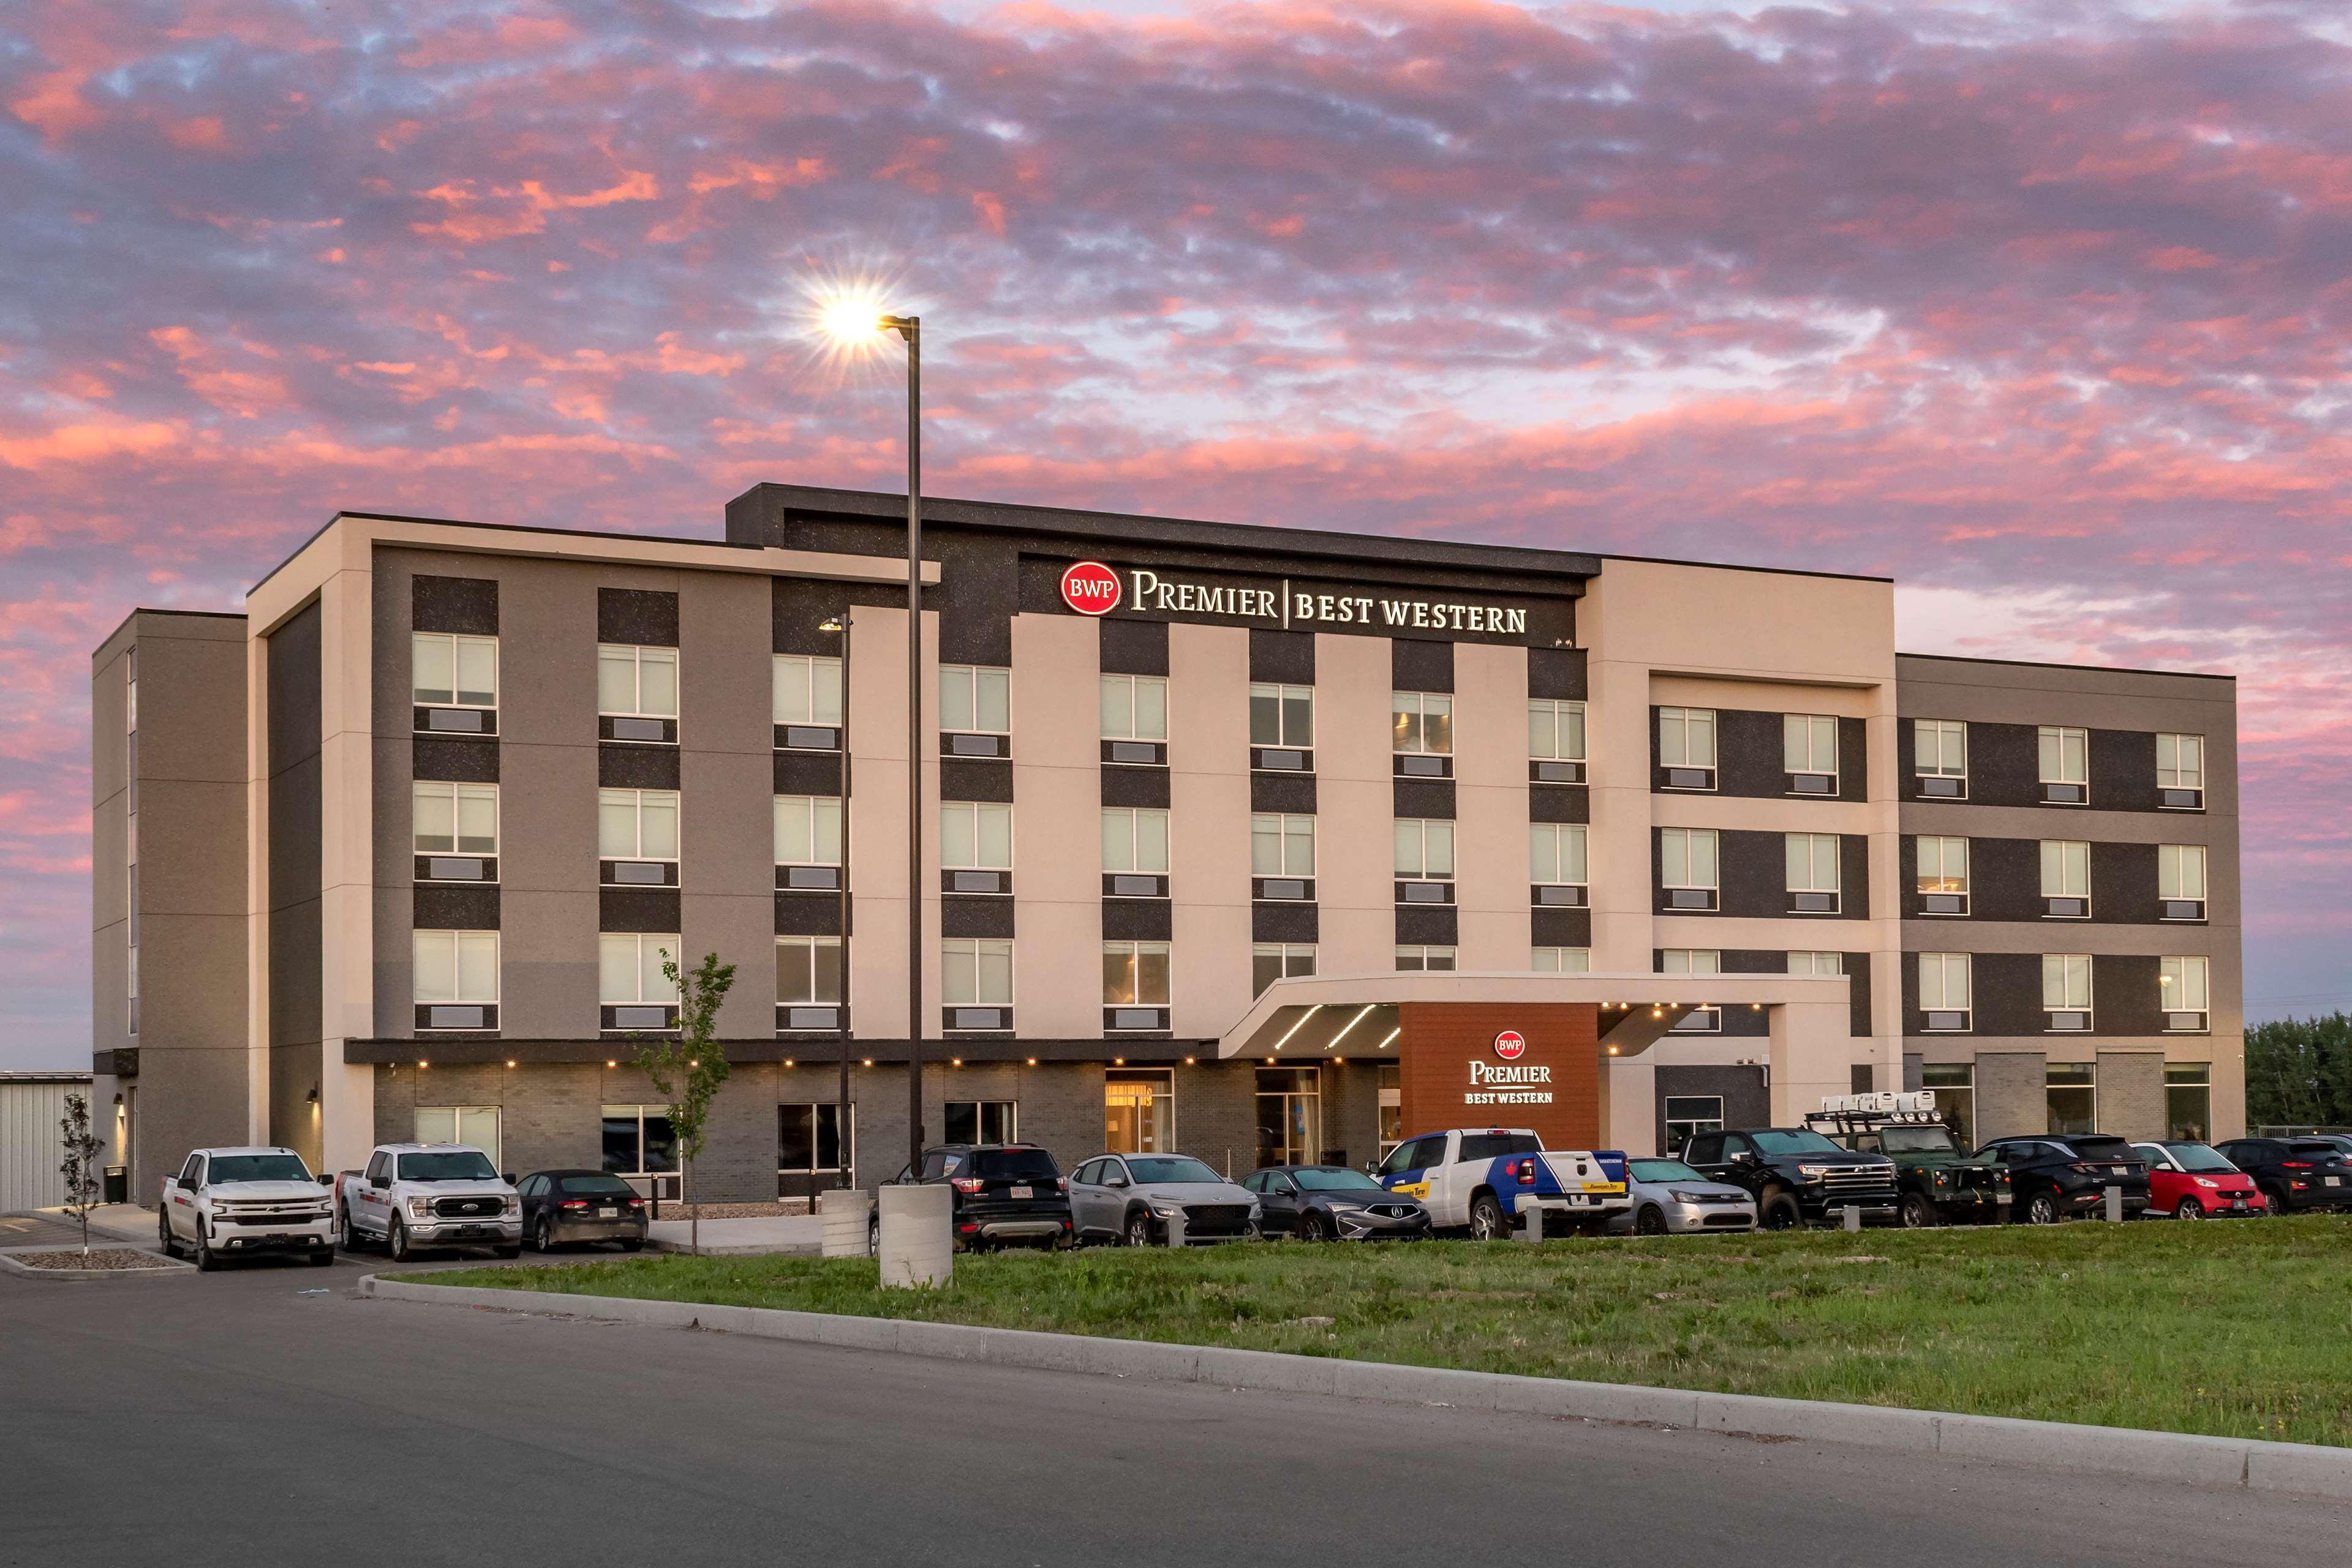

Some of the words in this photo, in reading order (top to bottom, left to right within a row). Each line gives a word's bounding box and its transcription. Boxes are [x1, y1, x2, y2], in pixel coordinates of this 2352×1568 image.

[1070, 579, 1114, 598] BWP
[1130, 570, 1279, 618] PREMIER
[1294, 594, 1373, 624] BEST
[1379, 600, 1527, 633] WESTERN
[1499, 1040, 1522, 1050] BWP
[1468, 1060, 1552, 1085] PREMIER
[1464, 1093, 1496, 1104] BEST
[1496, 1092, 1553, 1104] WESTERN
[1414, 1187, 1425, 1196] Tire
